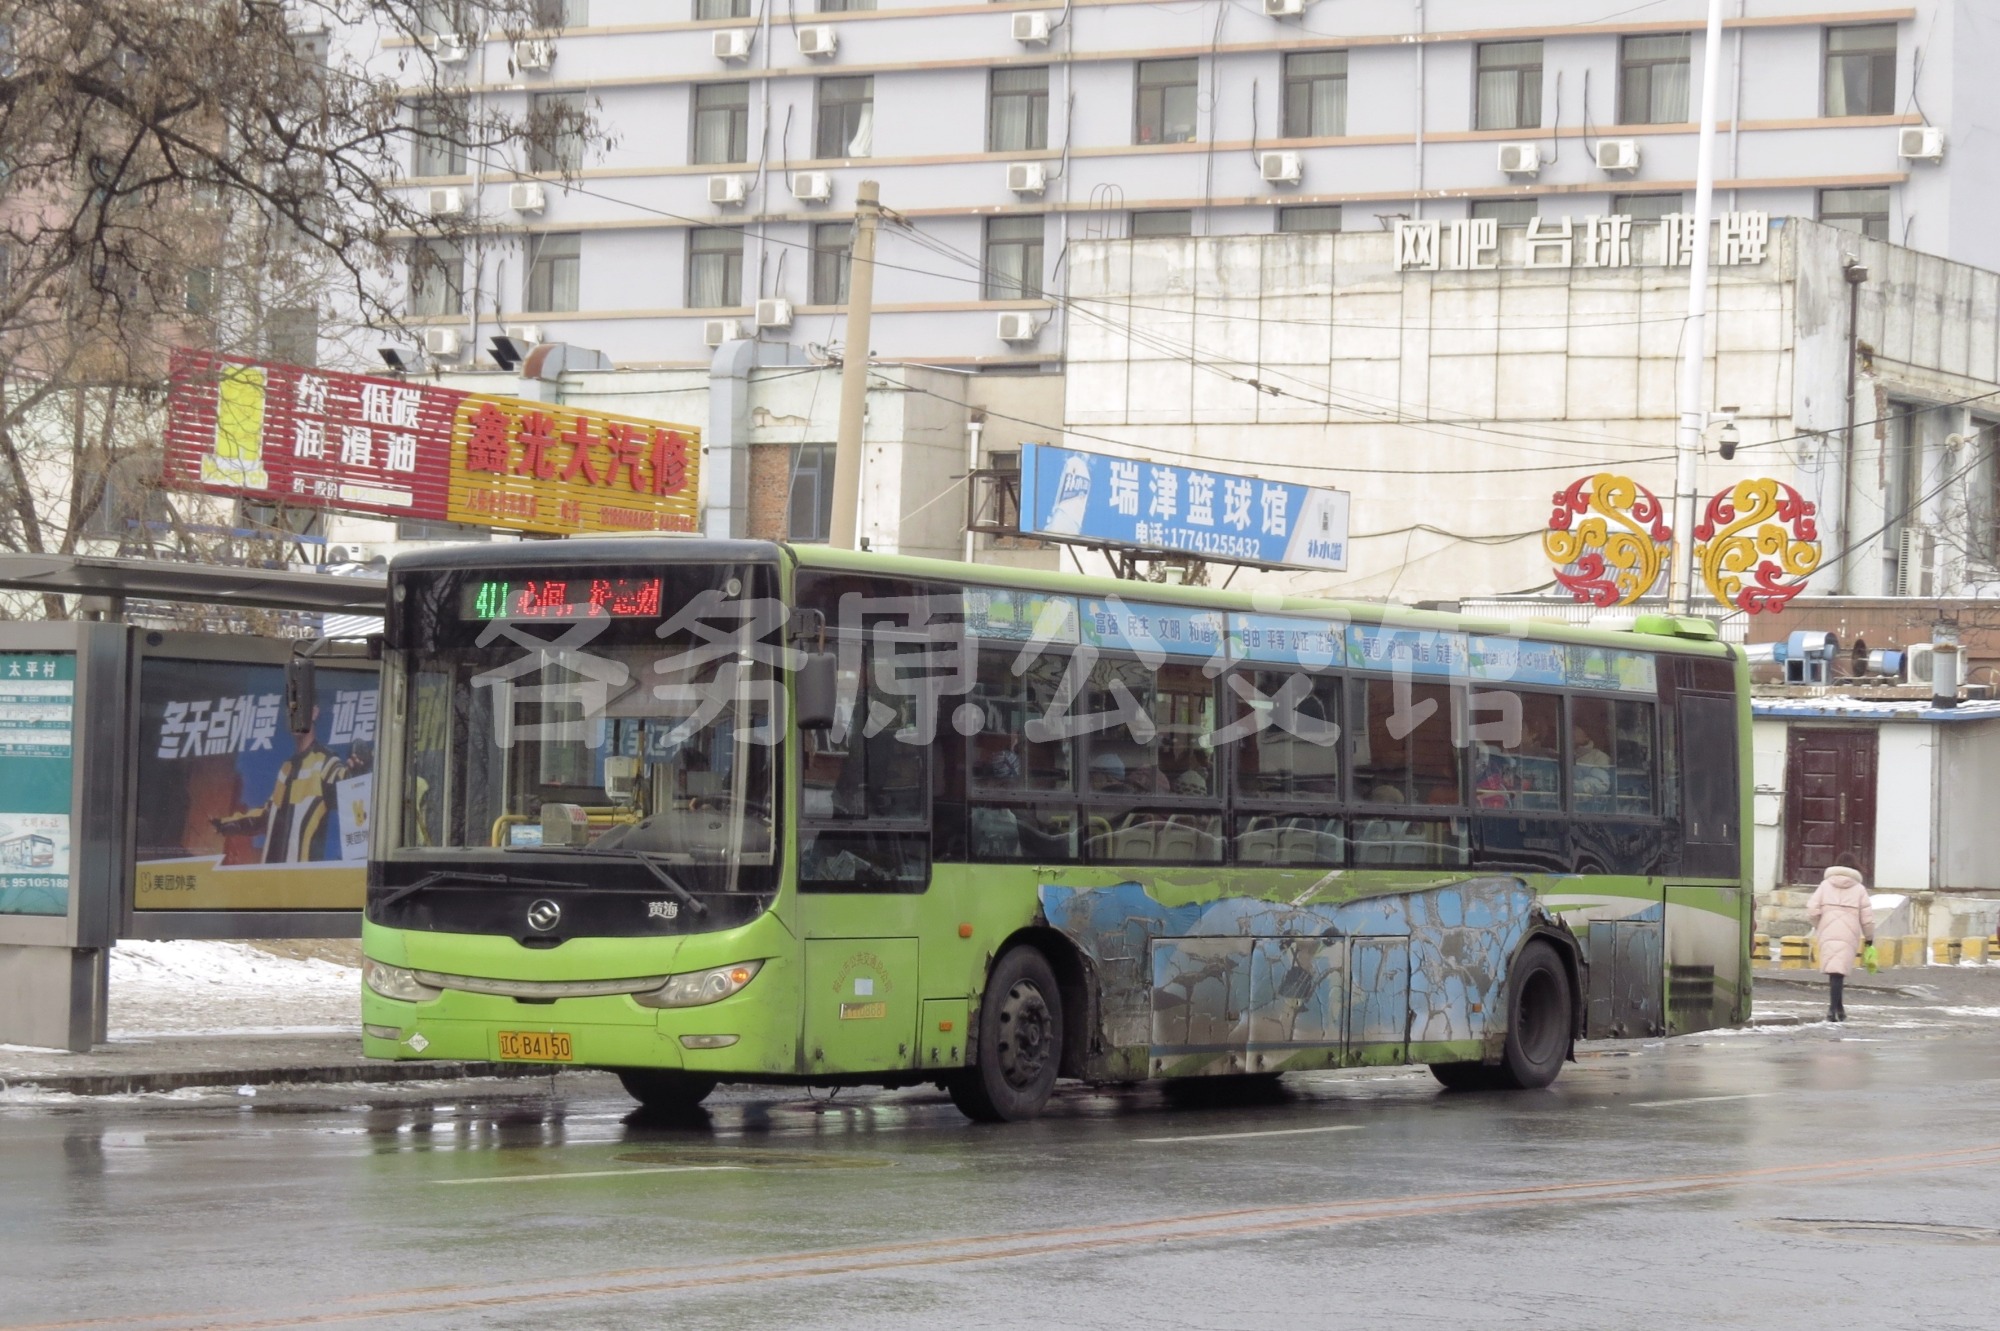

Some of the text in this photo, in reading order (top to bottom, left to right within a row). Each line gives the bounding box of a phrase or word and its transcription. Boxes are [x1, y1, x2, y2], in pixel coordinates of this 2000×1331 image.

[1394, 217, 1499, 272] 网吧
[1524, 214, 1633, 269] 台球
[296, 373, 422, 430] 统一低碳
[293, 418, 417, 472] 润滑油
[466, 403, 689, 497] 鑫光大汽修
[1108, 461, 1289, 537] 瑞津篮球馆
[475, 582, 509, 618] 411
[1095, 612, 1119, 636] 富强
[1127, 614, 1151, 638] 民主
[1158, 616, 1181, 641] 文明
[1242, 625, 1261, 648] 自由
[1267, 628, 1285, 650] 平等
[8, 661, 57, 678] 太平村
[157, 693, 283, 759] 冬天点外卖
[12, 877, 69, 888] 95105188
[153, 874, 198, 892] 美团外卖
[648, 901, 679, 919] 黄海
